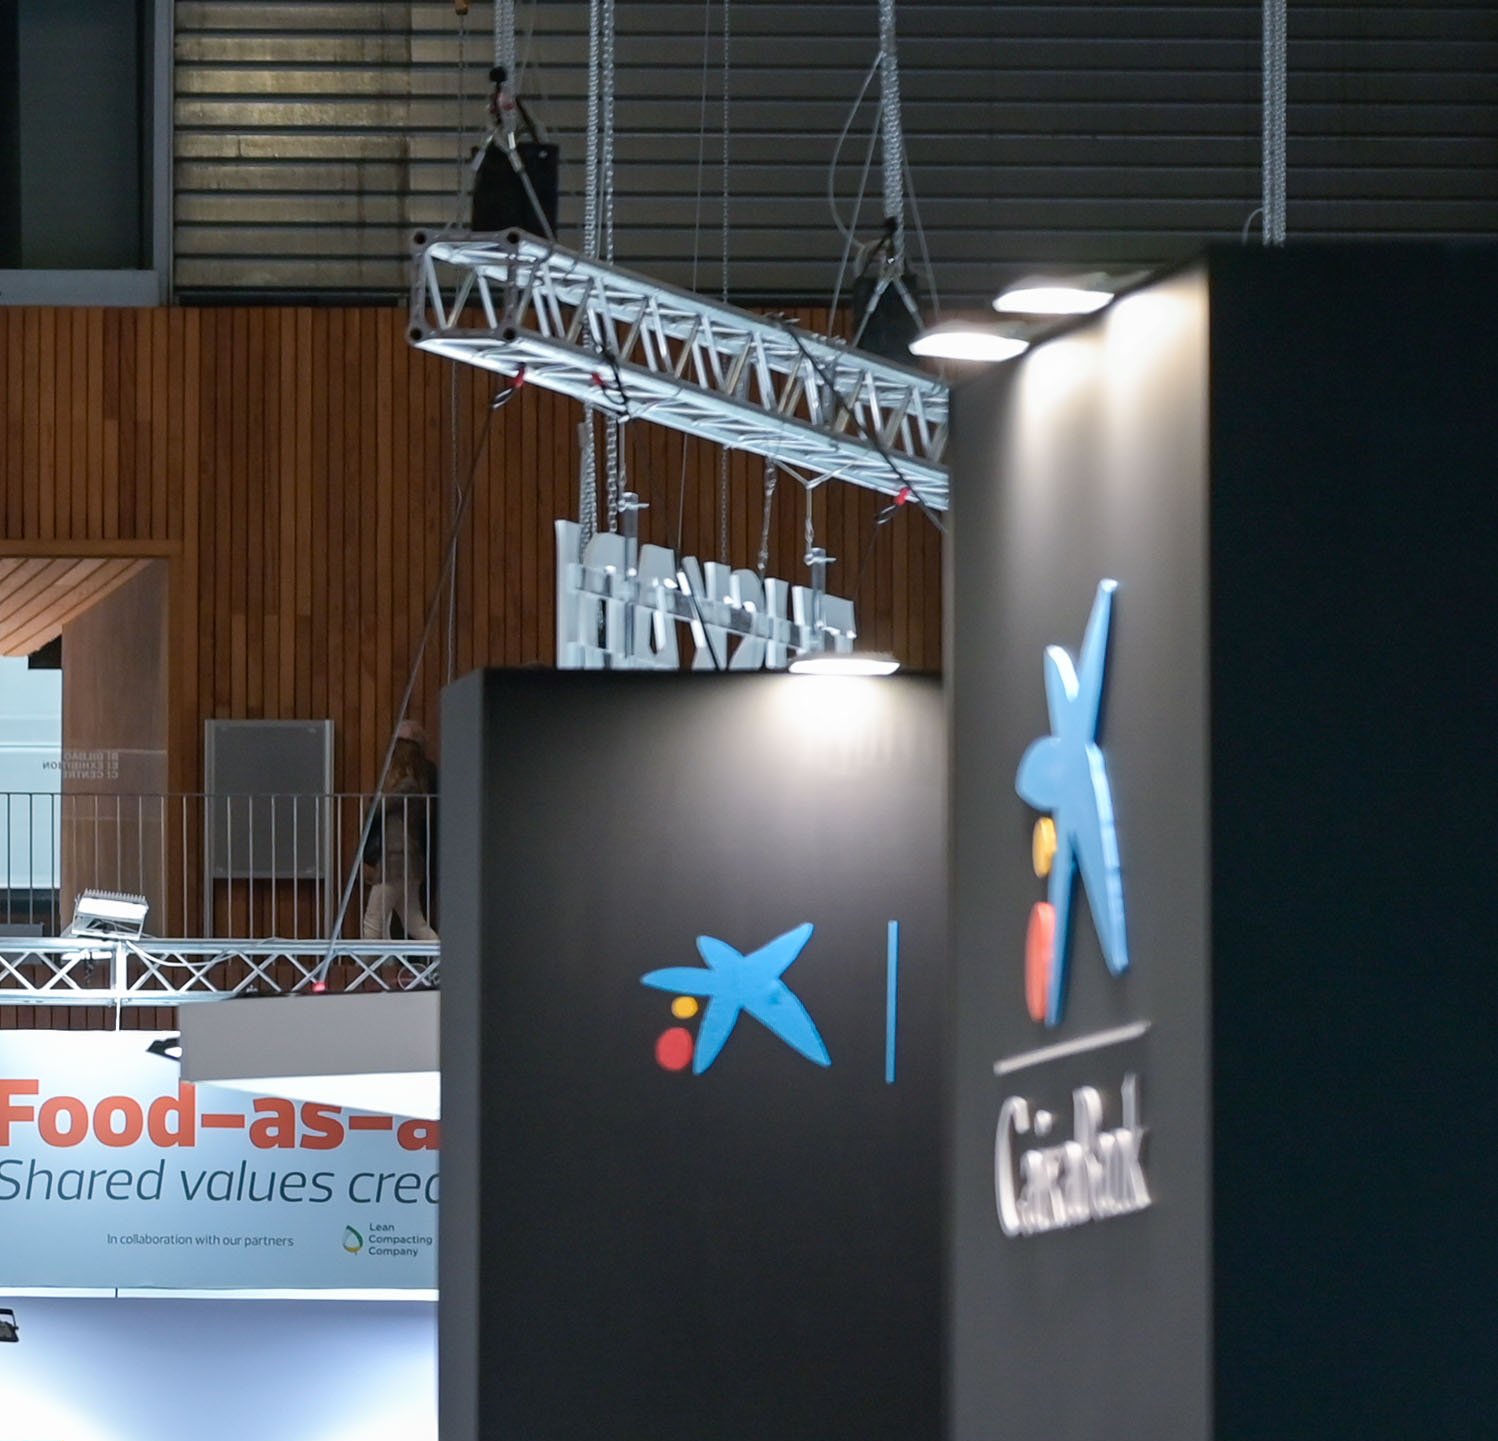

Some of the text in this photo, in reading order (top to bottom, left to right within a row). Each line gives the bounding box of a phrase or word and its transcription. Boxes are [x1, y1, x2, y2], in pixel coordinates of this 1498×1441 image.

[180, 1160, 334, 1203] values
[369, 1223, 395, 1232] Lean
[107, 1234, 294, 1248] In collaboration with our partners
[369, 1235, 433, 1246] Compacting
[369, 1247, 419, 1257] Company
